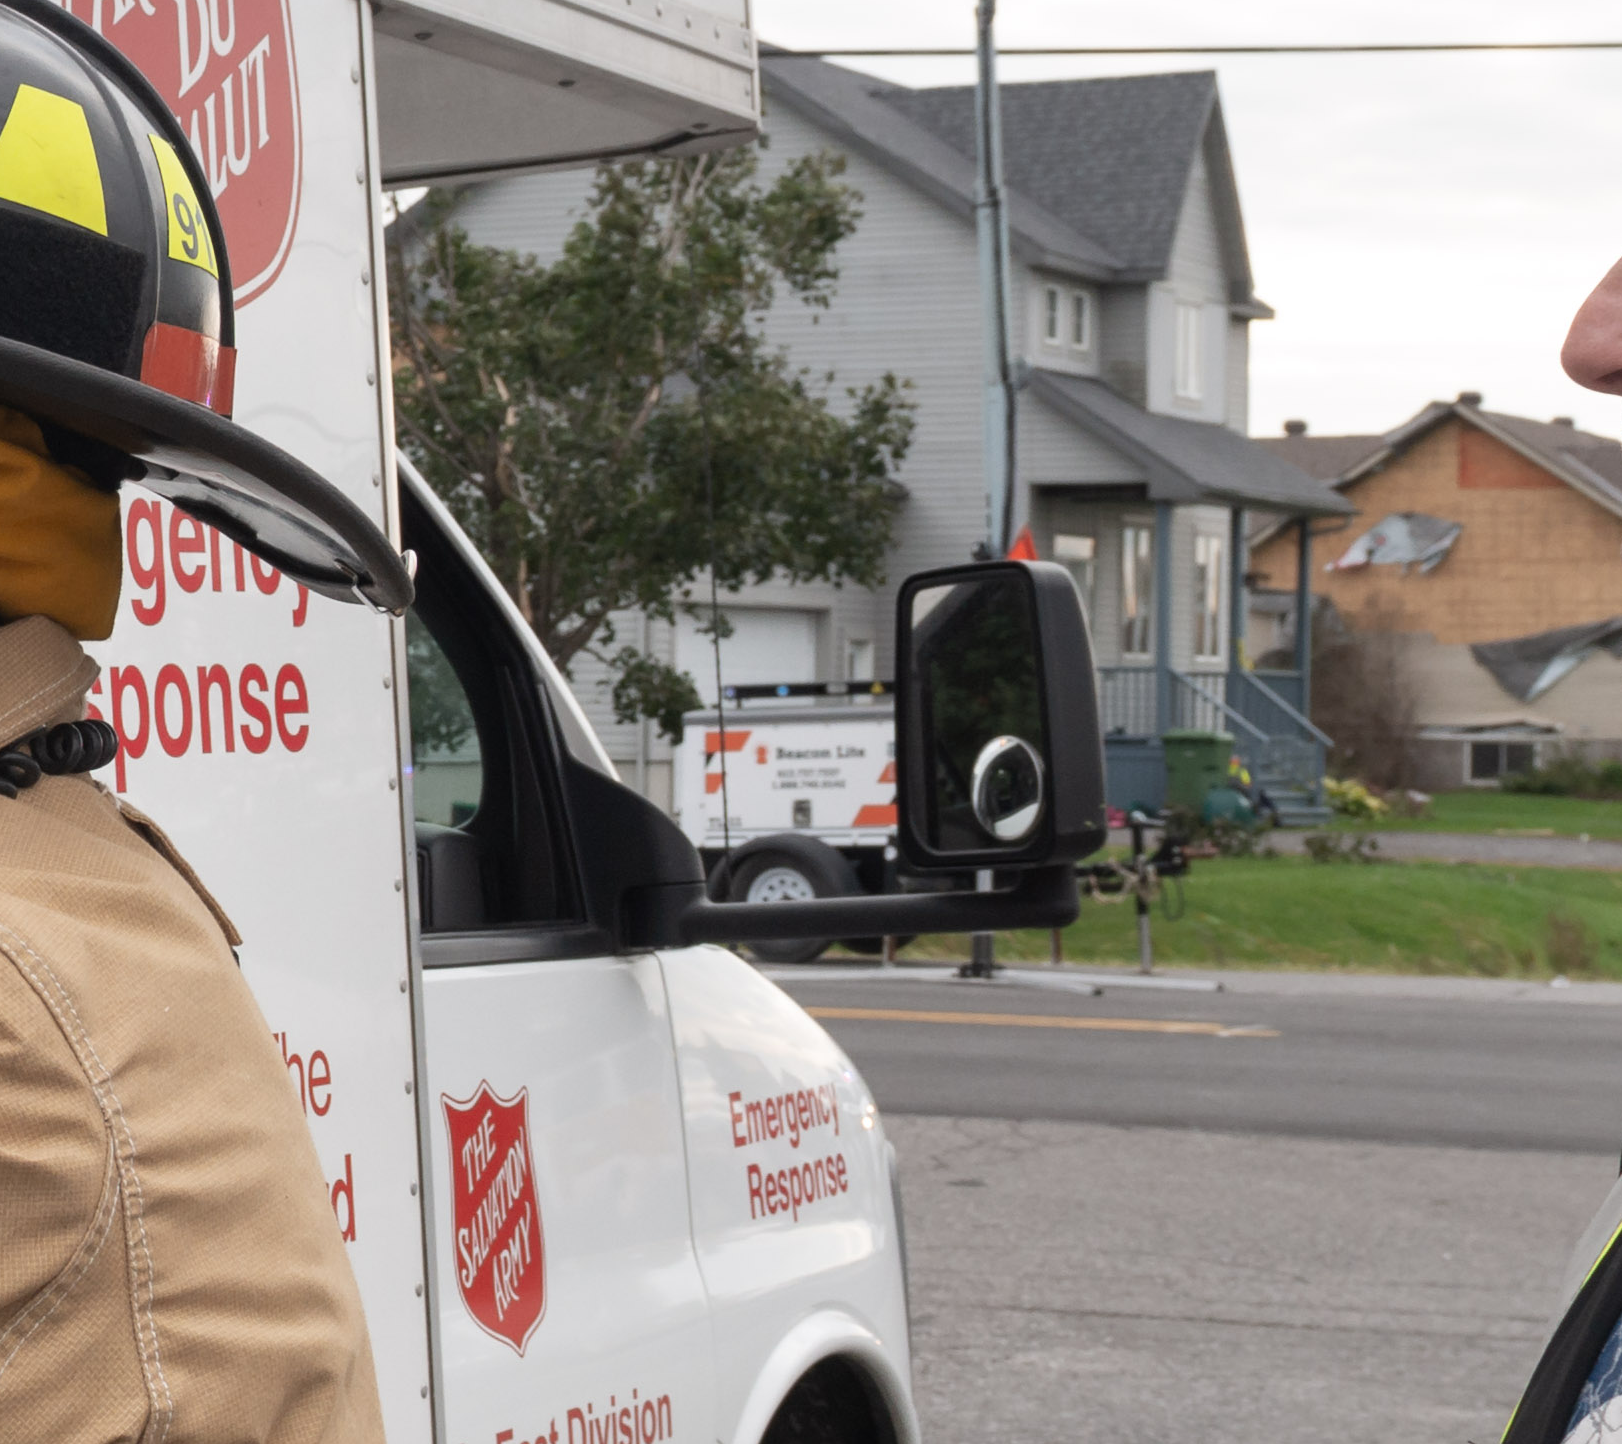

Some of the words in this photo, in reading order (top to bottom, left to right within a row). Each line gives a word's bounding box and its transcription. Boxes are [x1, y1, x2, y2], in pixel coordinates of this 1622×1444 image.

[462, 1110, 497, 1194] THE
[728, 1082, 839, 1149] Emergency
[458, 1126, 527, 1288] SALVATION
[747, 1153, 848, 1223] Response
[492, 1201, 532, 1322] ARMY
